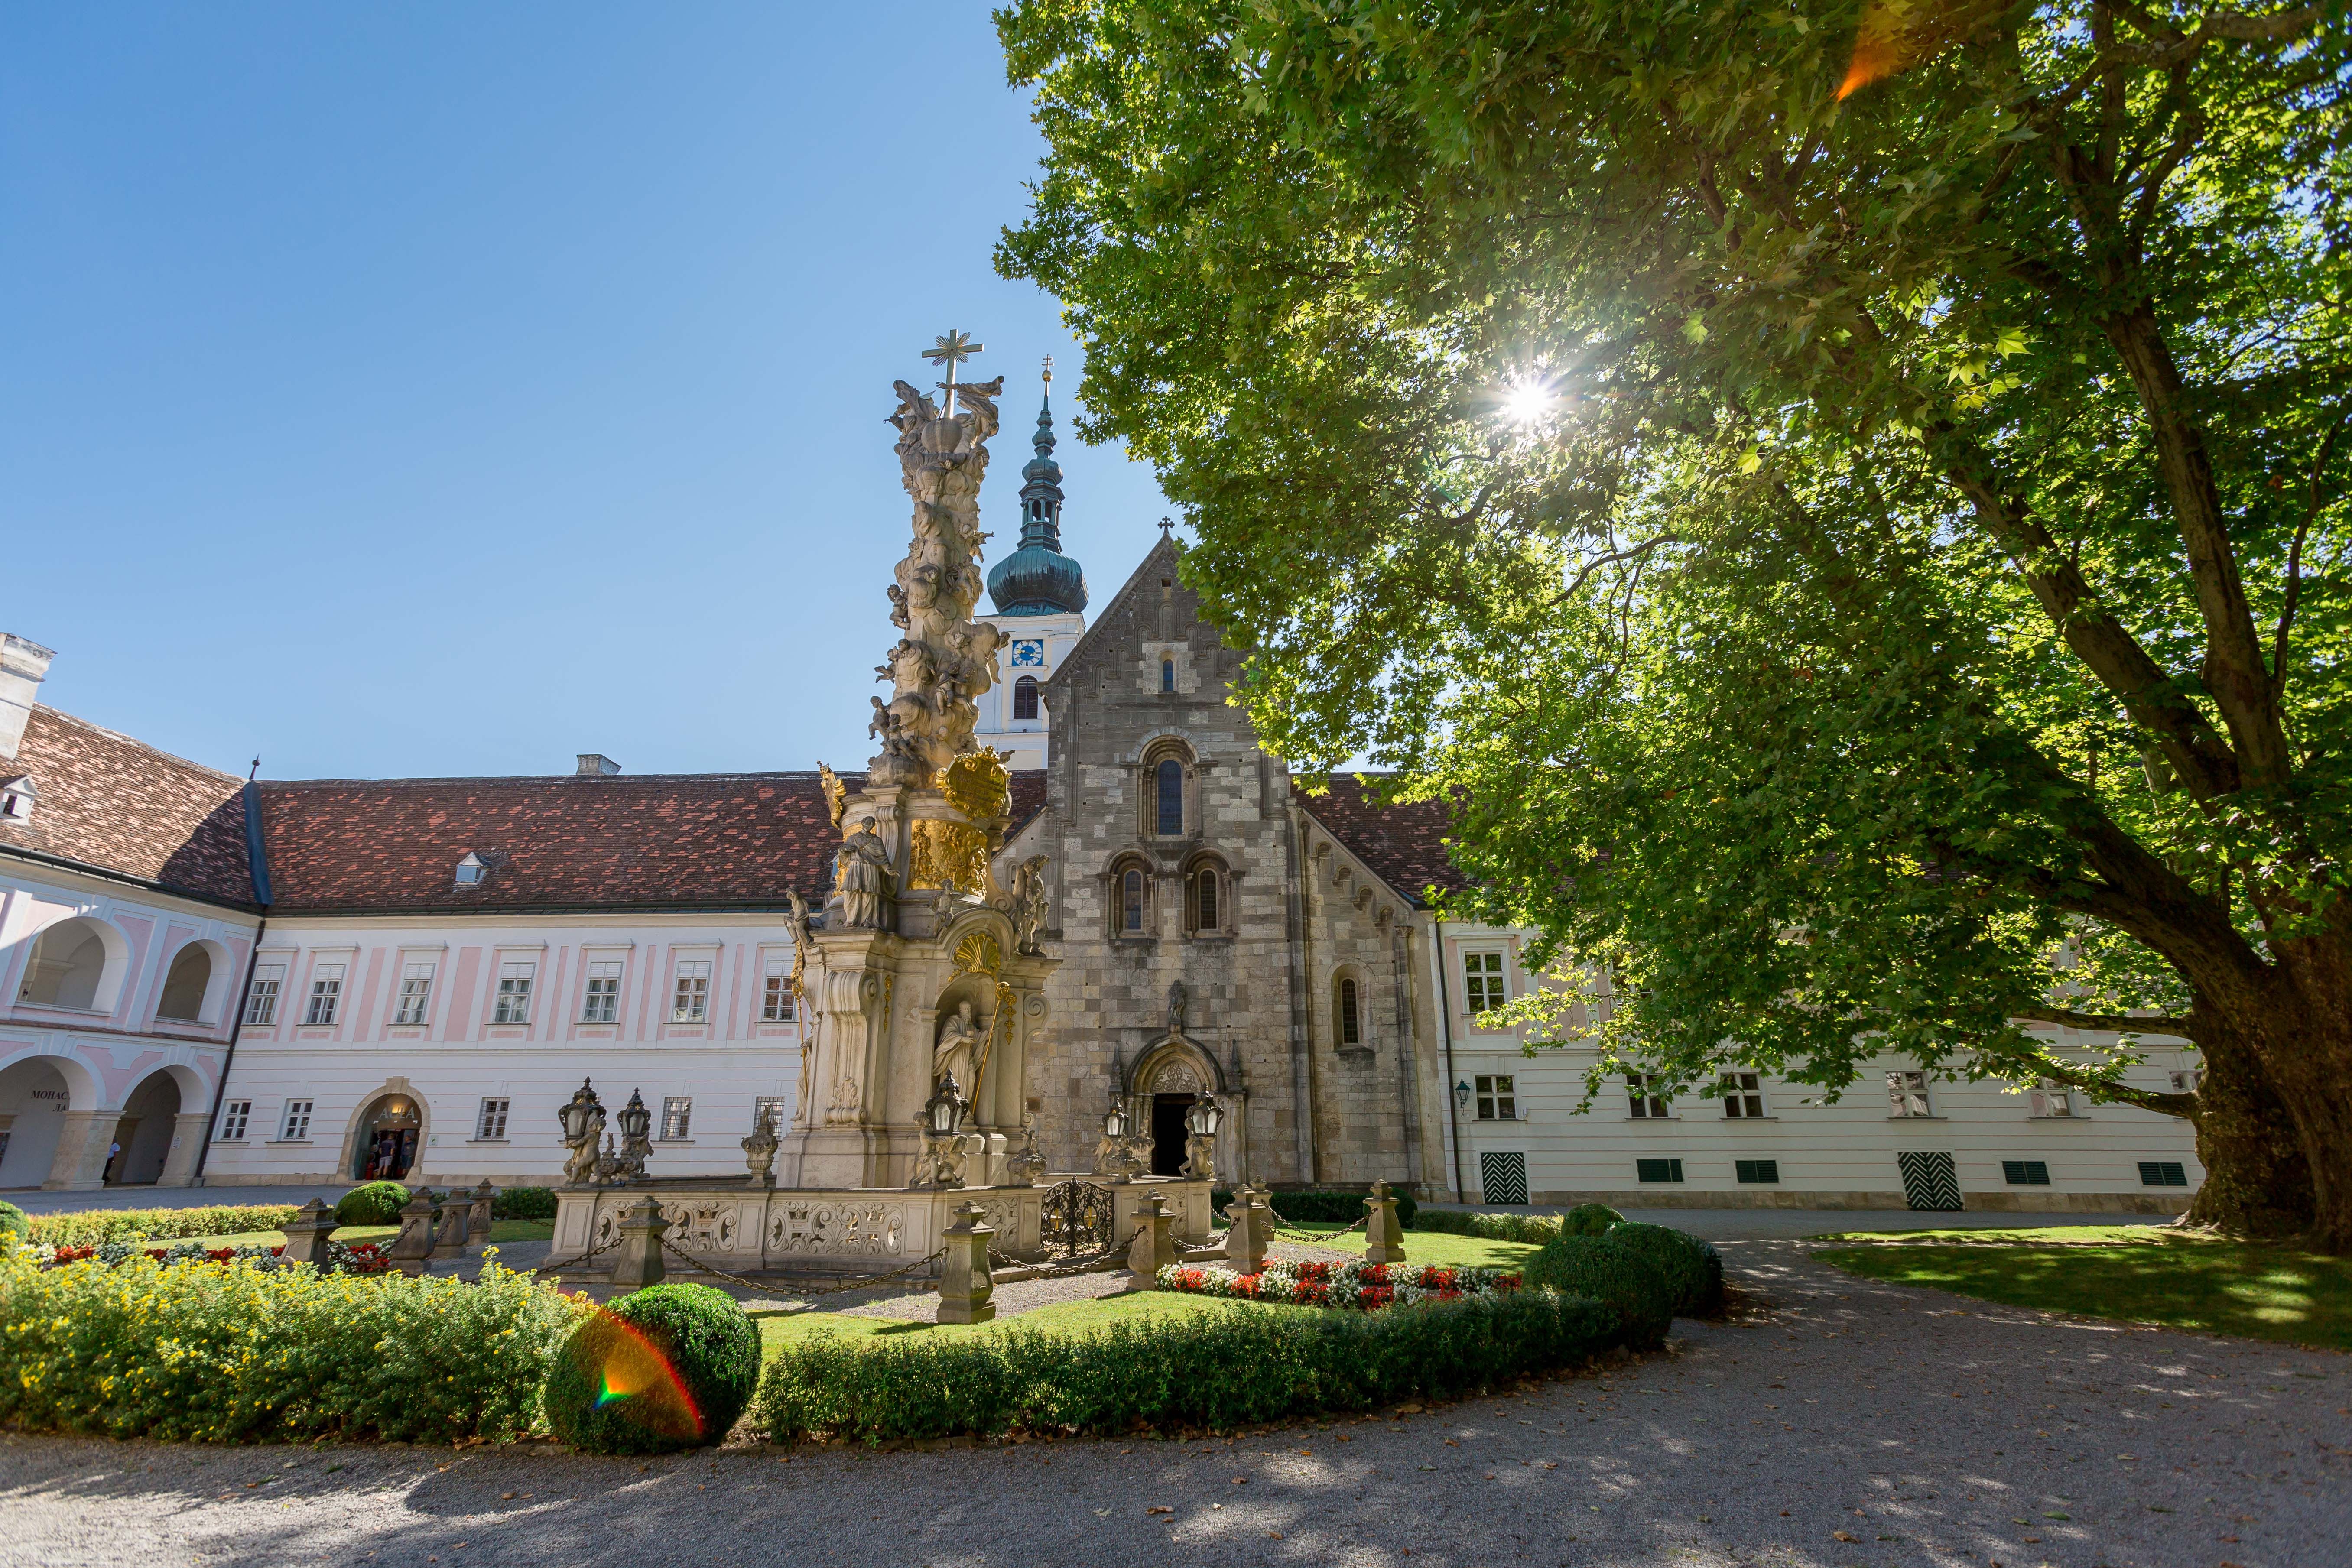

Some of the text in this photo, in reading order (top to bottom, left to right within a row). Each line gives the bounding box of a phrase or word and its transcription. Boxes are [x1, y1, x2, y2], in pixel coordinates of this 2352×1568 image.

[31, 1091, 70, 1099] МОНАС
[52, 1104, 69, 1112] ЛА
[378, 1107, 415, 1119] AULA
